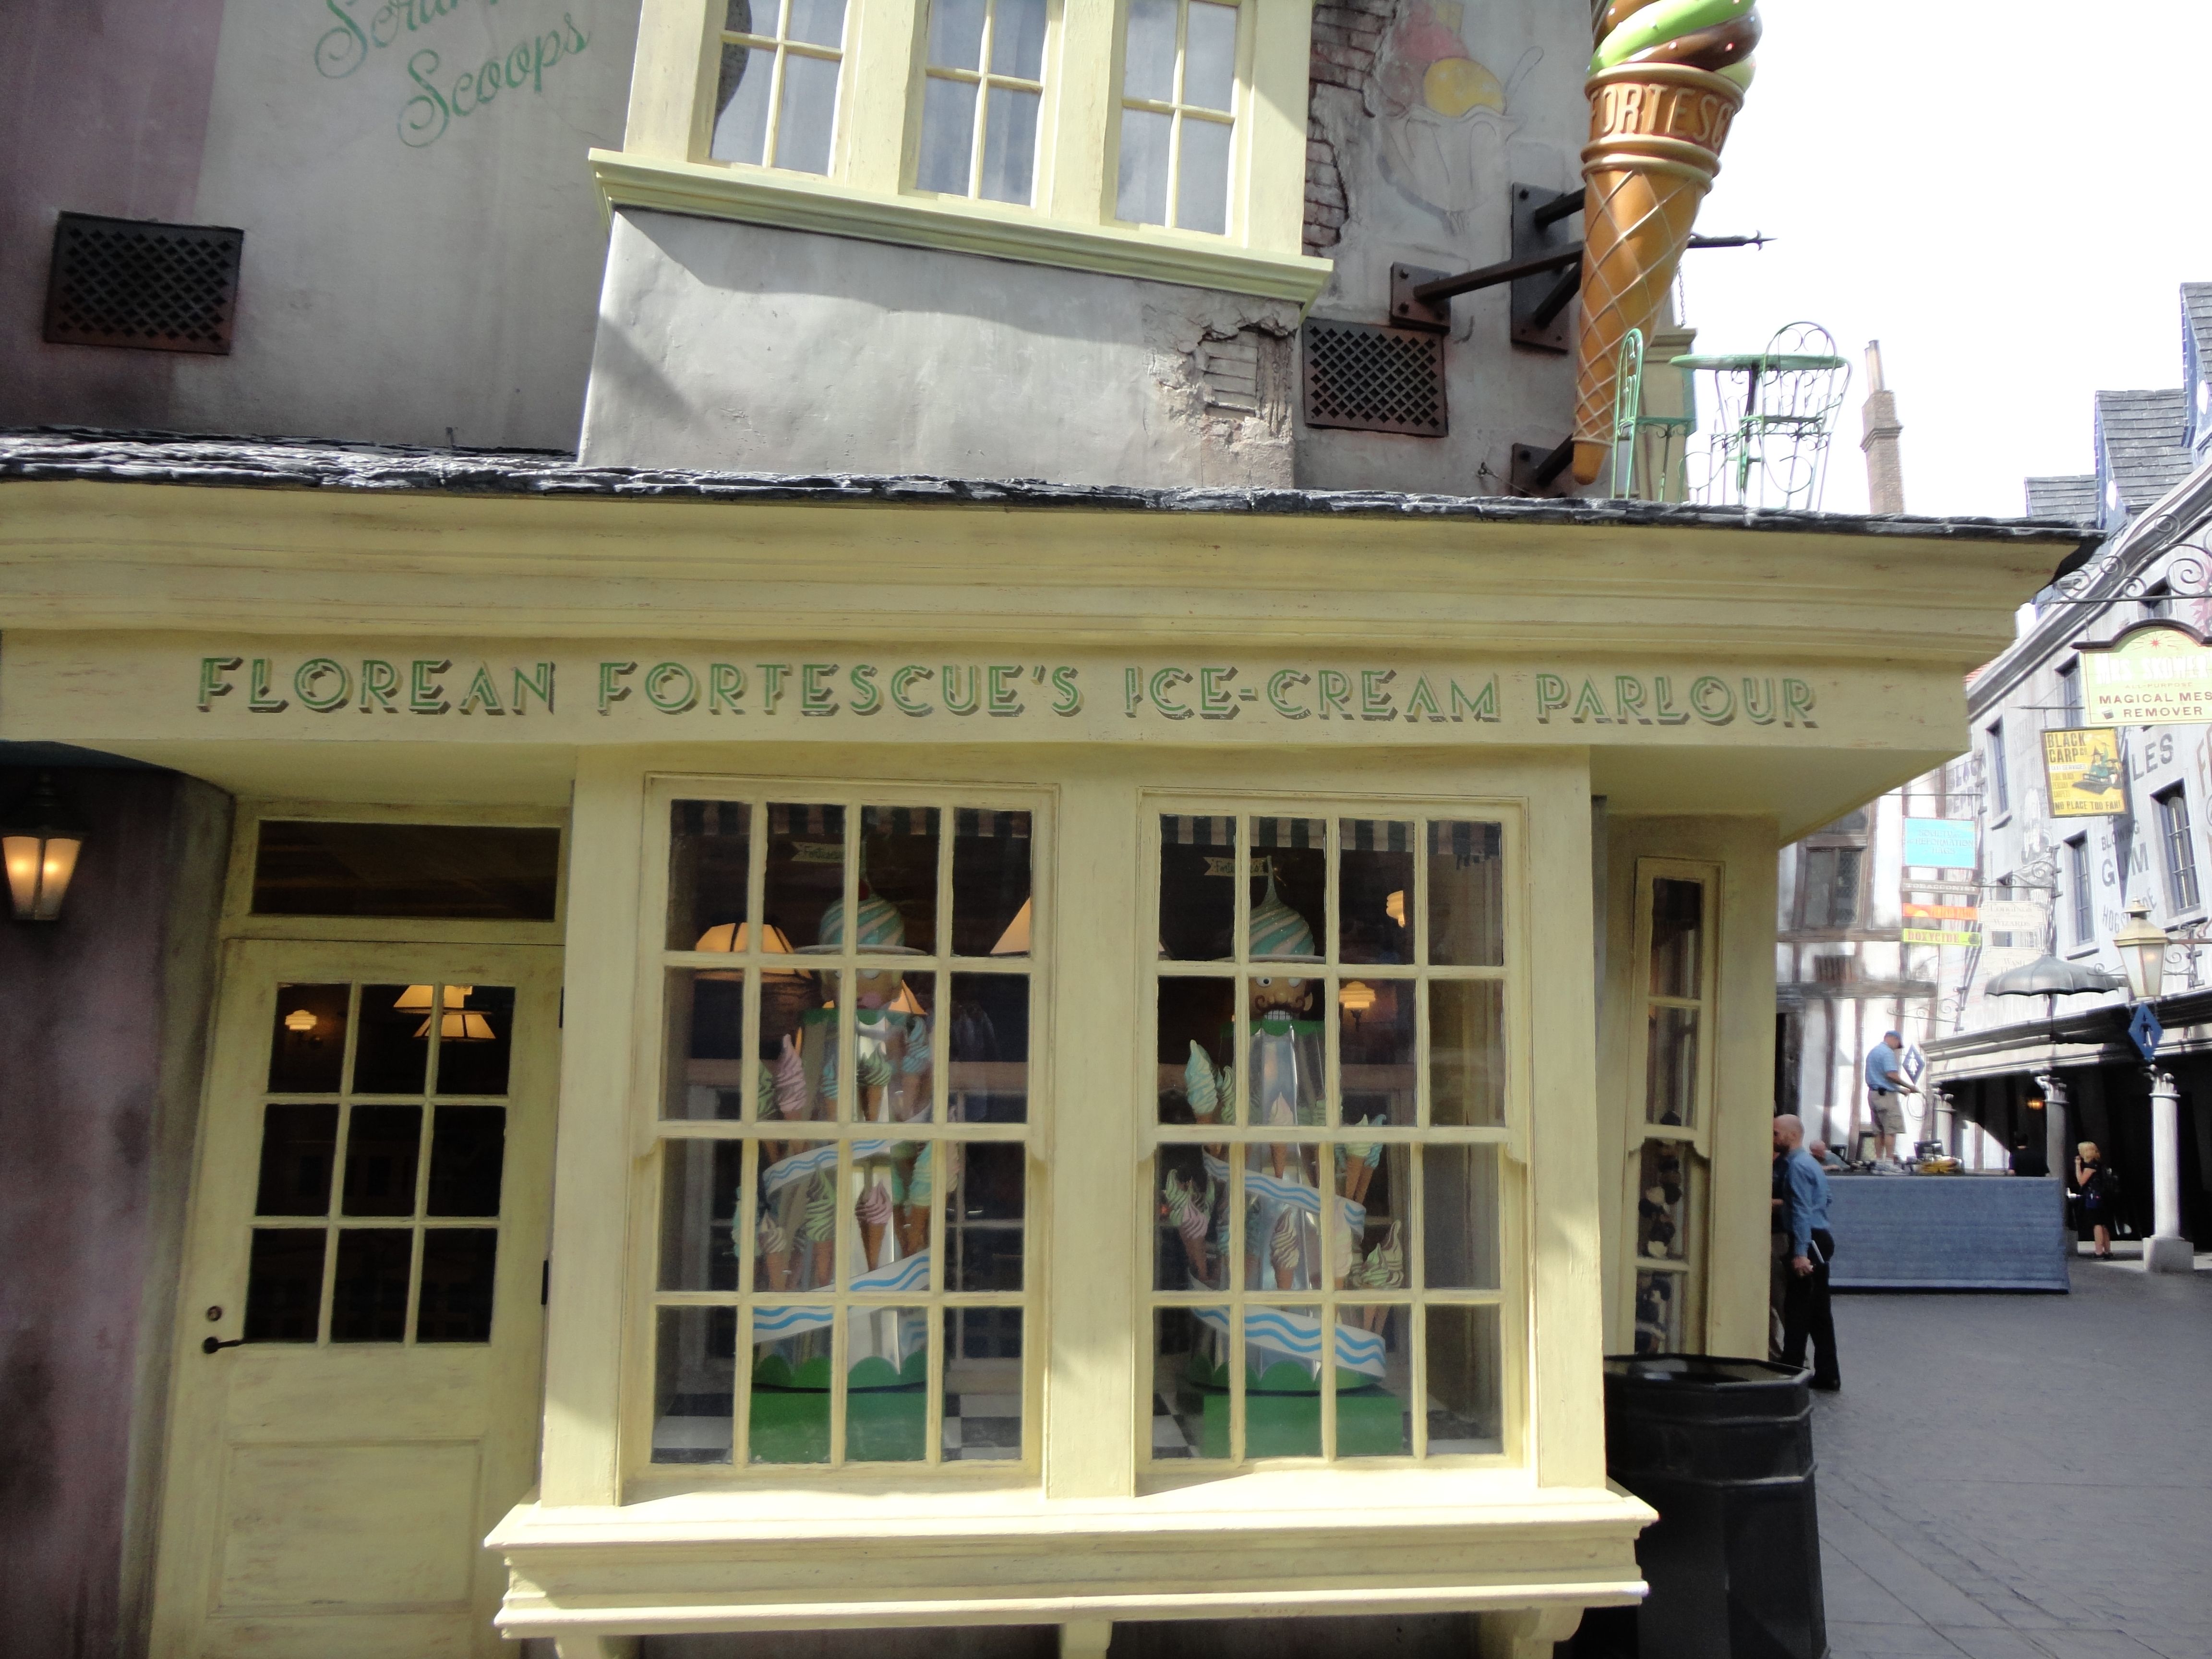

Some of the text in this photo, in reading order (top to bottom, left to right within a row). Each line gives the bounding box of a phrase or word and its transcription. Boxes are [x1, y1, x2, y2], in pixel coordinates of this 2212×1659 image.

[397, 12, 591, 148] Scoops
[197, 656, 1819, 729] FLOREAN FORTESCUE'S ICE-CREAM PARLOUR
[2099, 693, 2174, 704] MAGICAL
[2123, 707, 2203, 718] REMOVER
[2047, 732, 2087, 748] BLACK
[2049, 748, 2079, 763] CARP
[2055, 802, 2065, 811] NO
[2066, 801, 2087, 810] PLACE
[2090, 801, 2103, 810] TOO
[1914, 837, 1973, 847] REFORMATION
[2102, 842, 2150, 888] GUM
[1906, 883, 1976, 891] TOBACCONIST
[1907, 930, 1959, 943] DOXYCIDE
